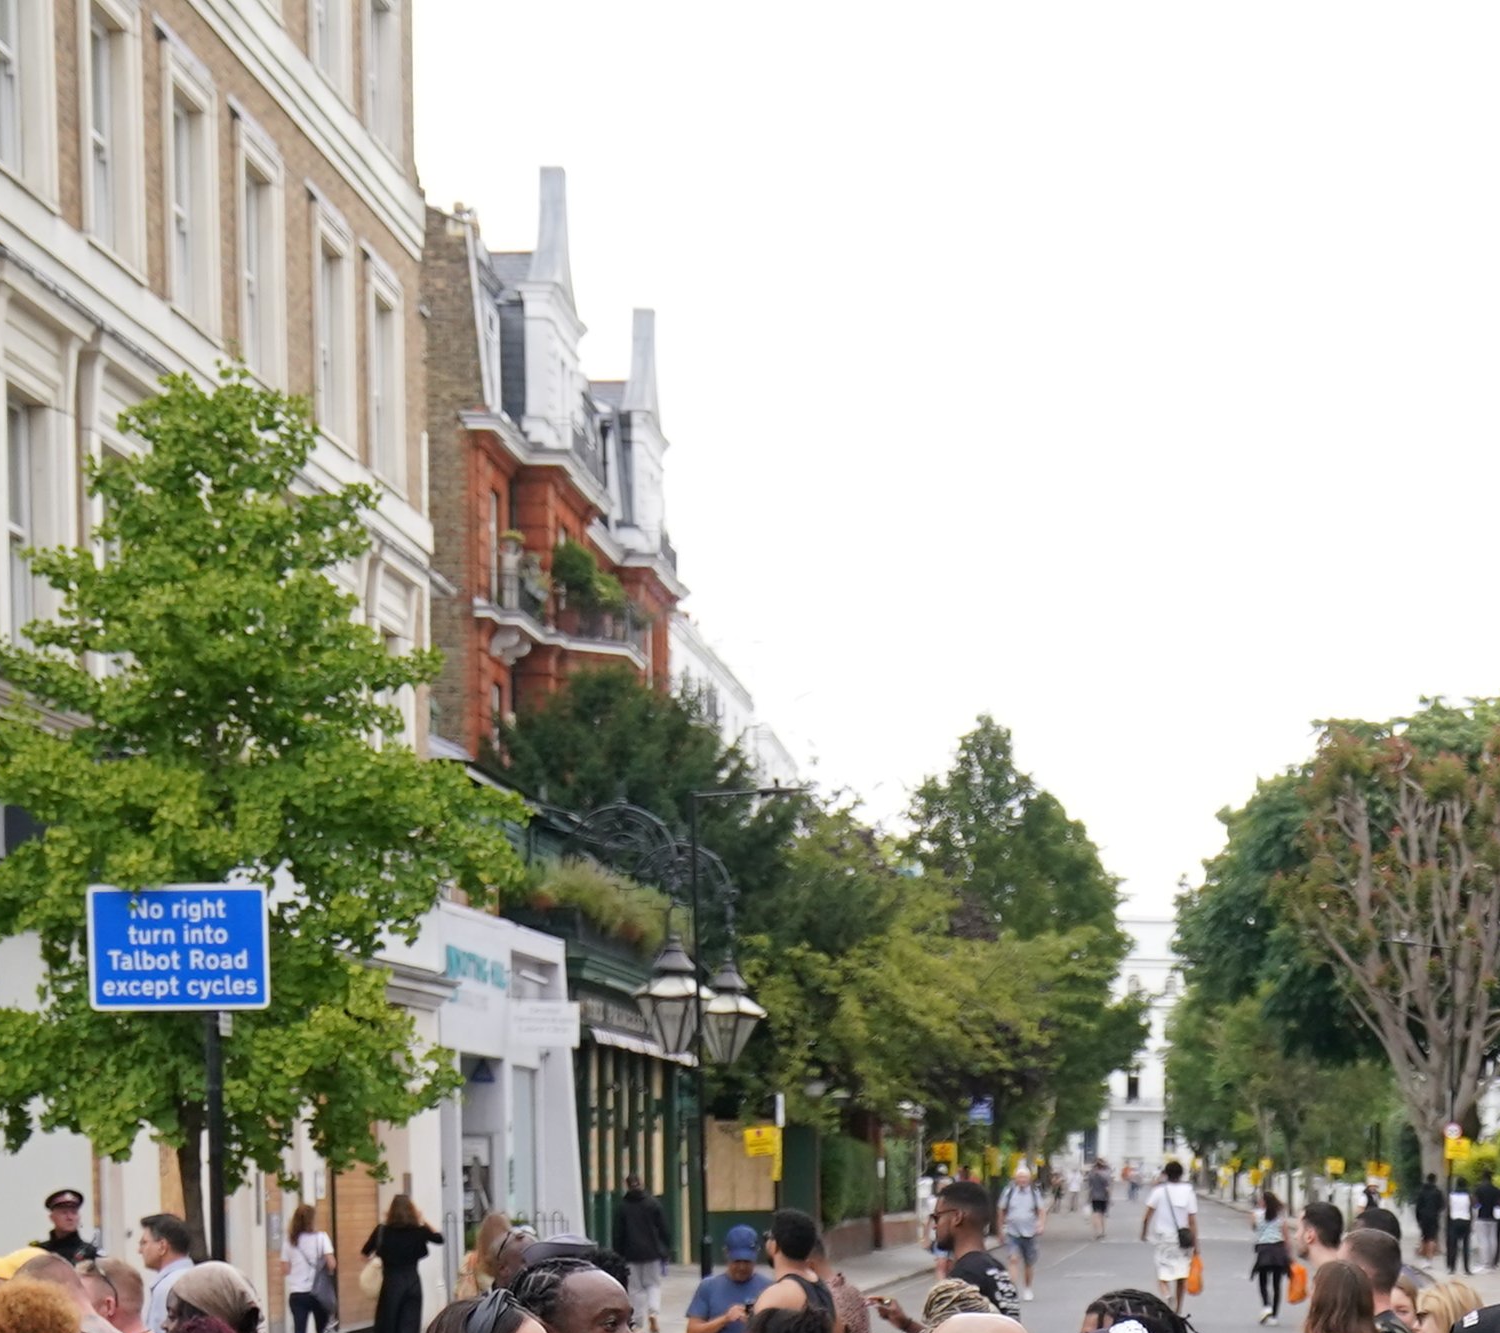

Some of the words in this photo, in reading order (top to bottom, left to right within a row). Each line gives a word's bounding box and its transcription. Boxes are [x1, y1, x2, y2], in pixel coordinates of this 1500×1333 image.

[171, 898, 227, 923] right
[128, 924, 176, 945] turn
[183, 924, 229, 945] into
[107, 949, 181, 971] Talbot
[189, 948, 248, 970] Road
[102, 975, 180, 999] except
[186, 974, 258, 999] cycles
